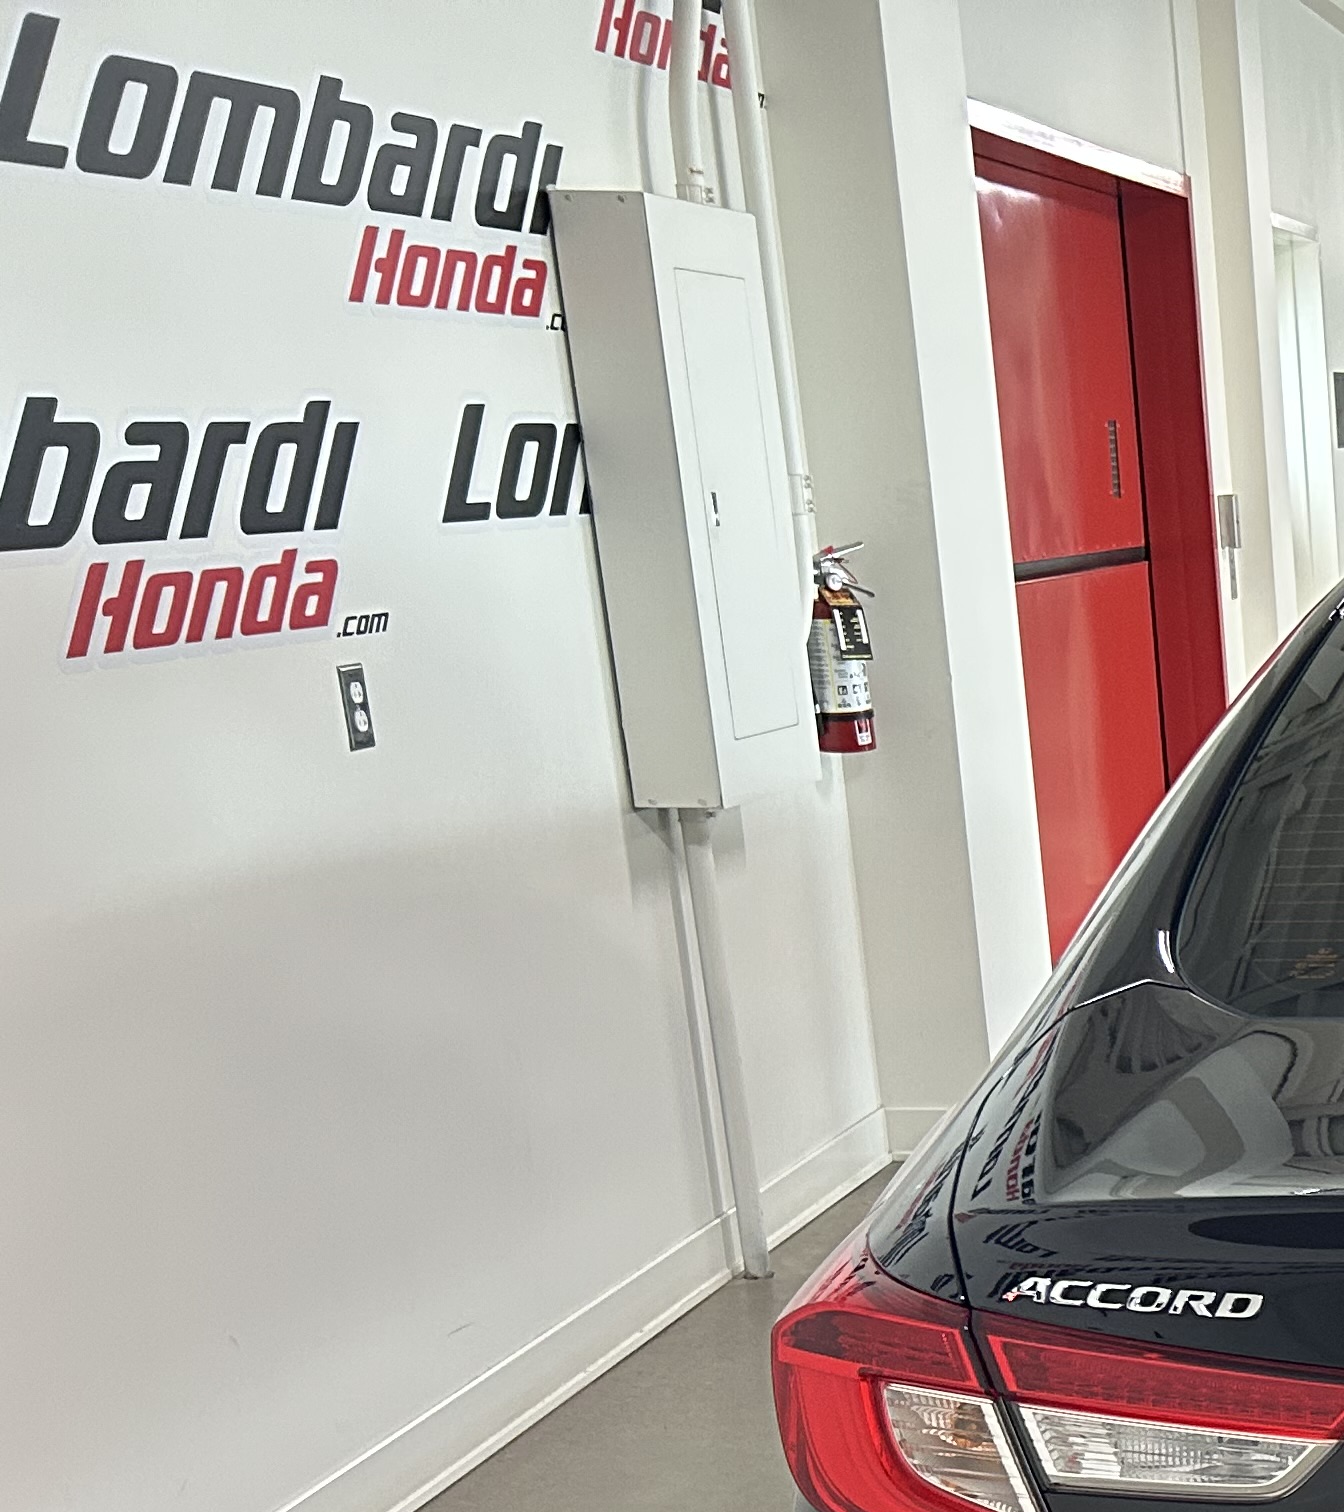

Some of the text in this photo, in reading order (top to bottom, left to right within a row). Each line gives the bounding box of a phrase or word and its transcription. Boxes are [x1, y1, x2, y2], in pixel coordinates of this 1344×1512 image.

[0, 12, 563, 235] Lombardi
[348, 225, 548, 317] Honda
[66, 548, 338, 658] Honda
[336, 612, 389, 637] .com
[1002, 1277, 1263, 1318] ACCORD
